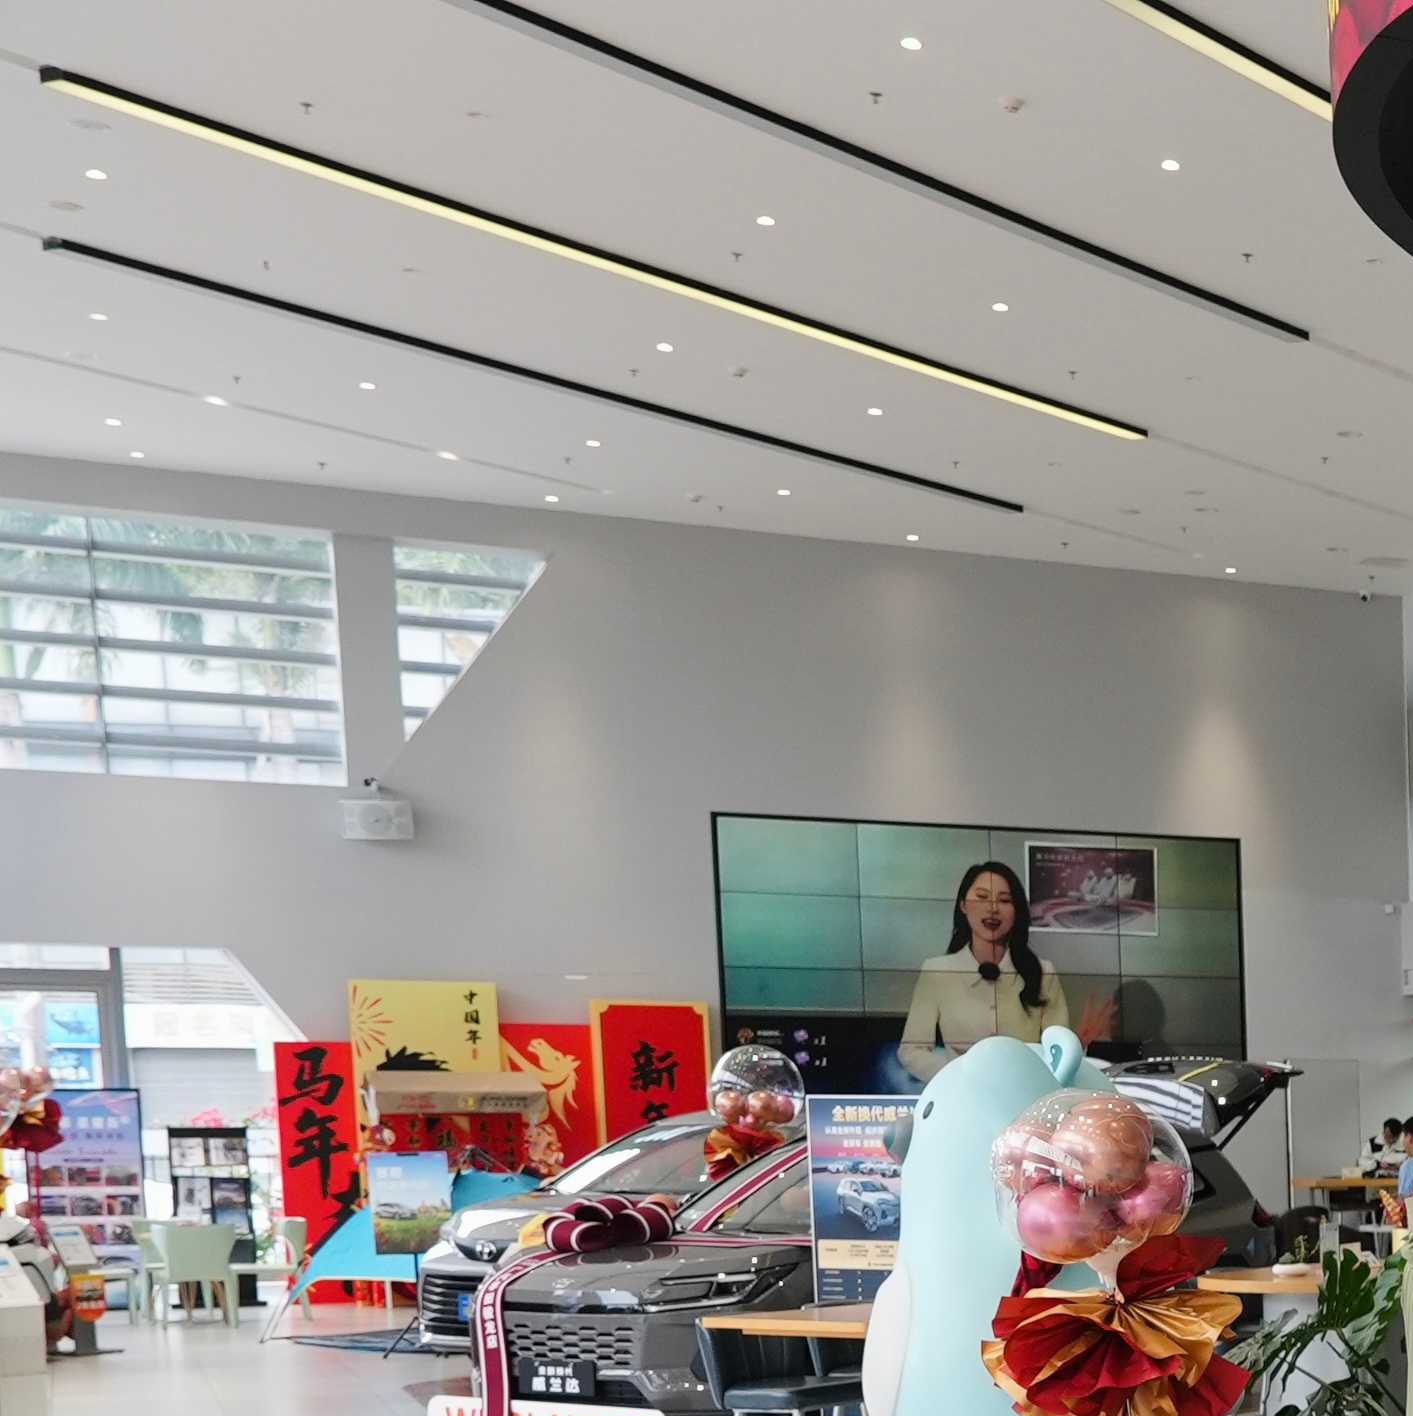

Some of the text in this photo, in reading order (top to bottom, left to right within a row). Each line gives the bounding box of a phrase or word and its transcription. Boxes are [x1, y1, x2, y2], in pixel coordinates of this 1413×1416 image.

[463, 988, 482, 1045] 中国年
[831, 1104, 914, 1123] 全新换代威兰
